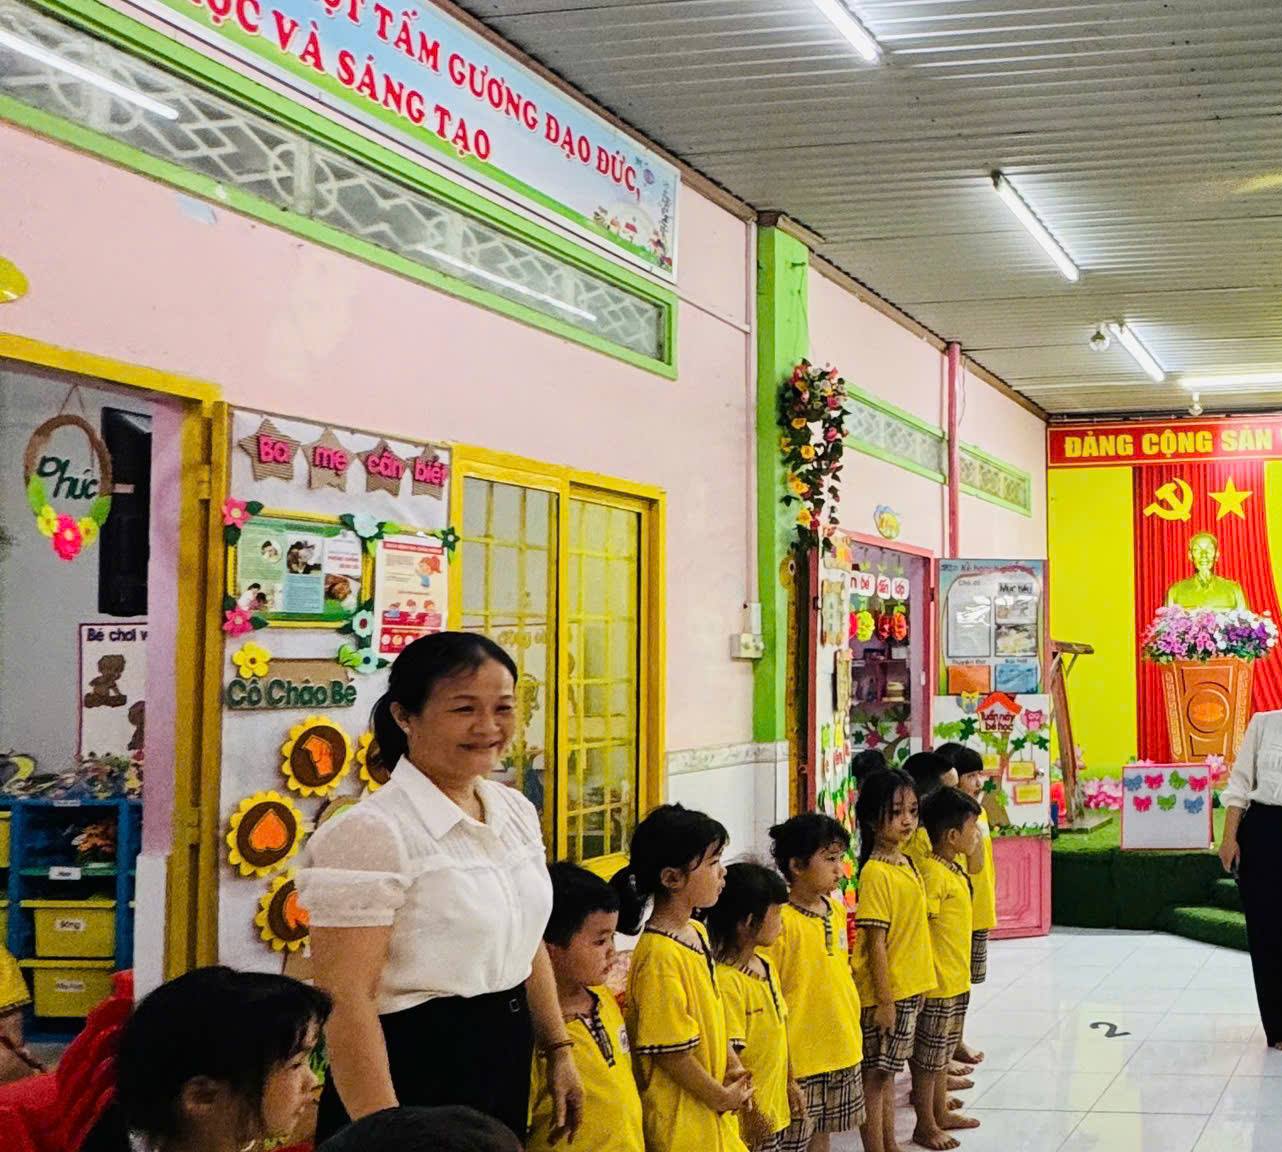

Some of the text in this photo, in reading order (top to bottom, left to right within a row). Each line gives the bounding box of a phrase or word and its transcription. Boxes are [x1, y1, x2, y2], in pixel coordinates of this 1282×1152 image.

[272, 10, 325, 73] VÀ
[337, 50, 425, 124] SÁNG
[434, 104, 491, 160] TẠO
[374, 3, 440, 72] TẤM
[449, 53, 538, 130] GƯƠNG
[545, 112, 591, 162] ĐẠO
[1064, 430, 1134, 458] ĐẢNG
[1141, 429, 1213, 459] CỘNG
[227, 679, 262, 707] Cô
[1089, 1021, 1132, 1039] 2
